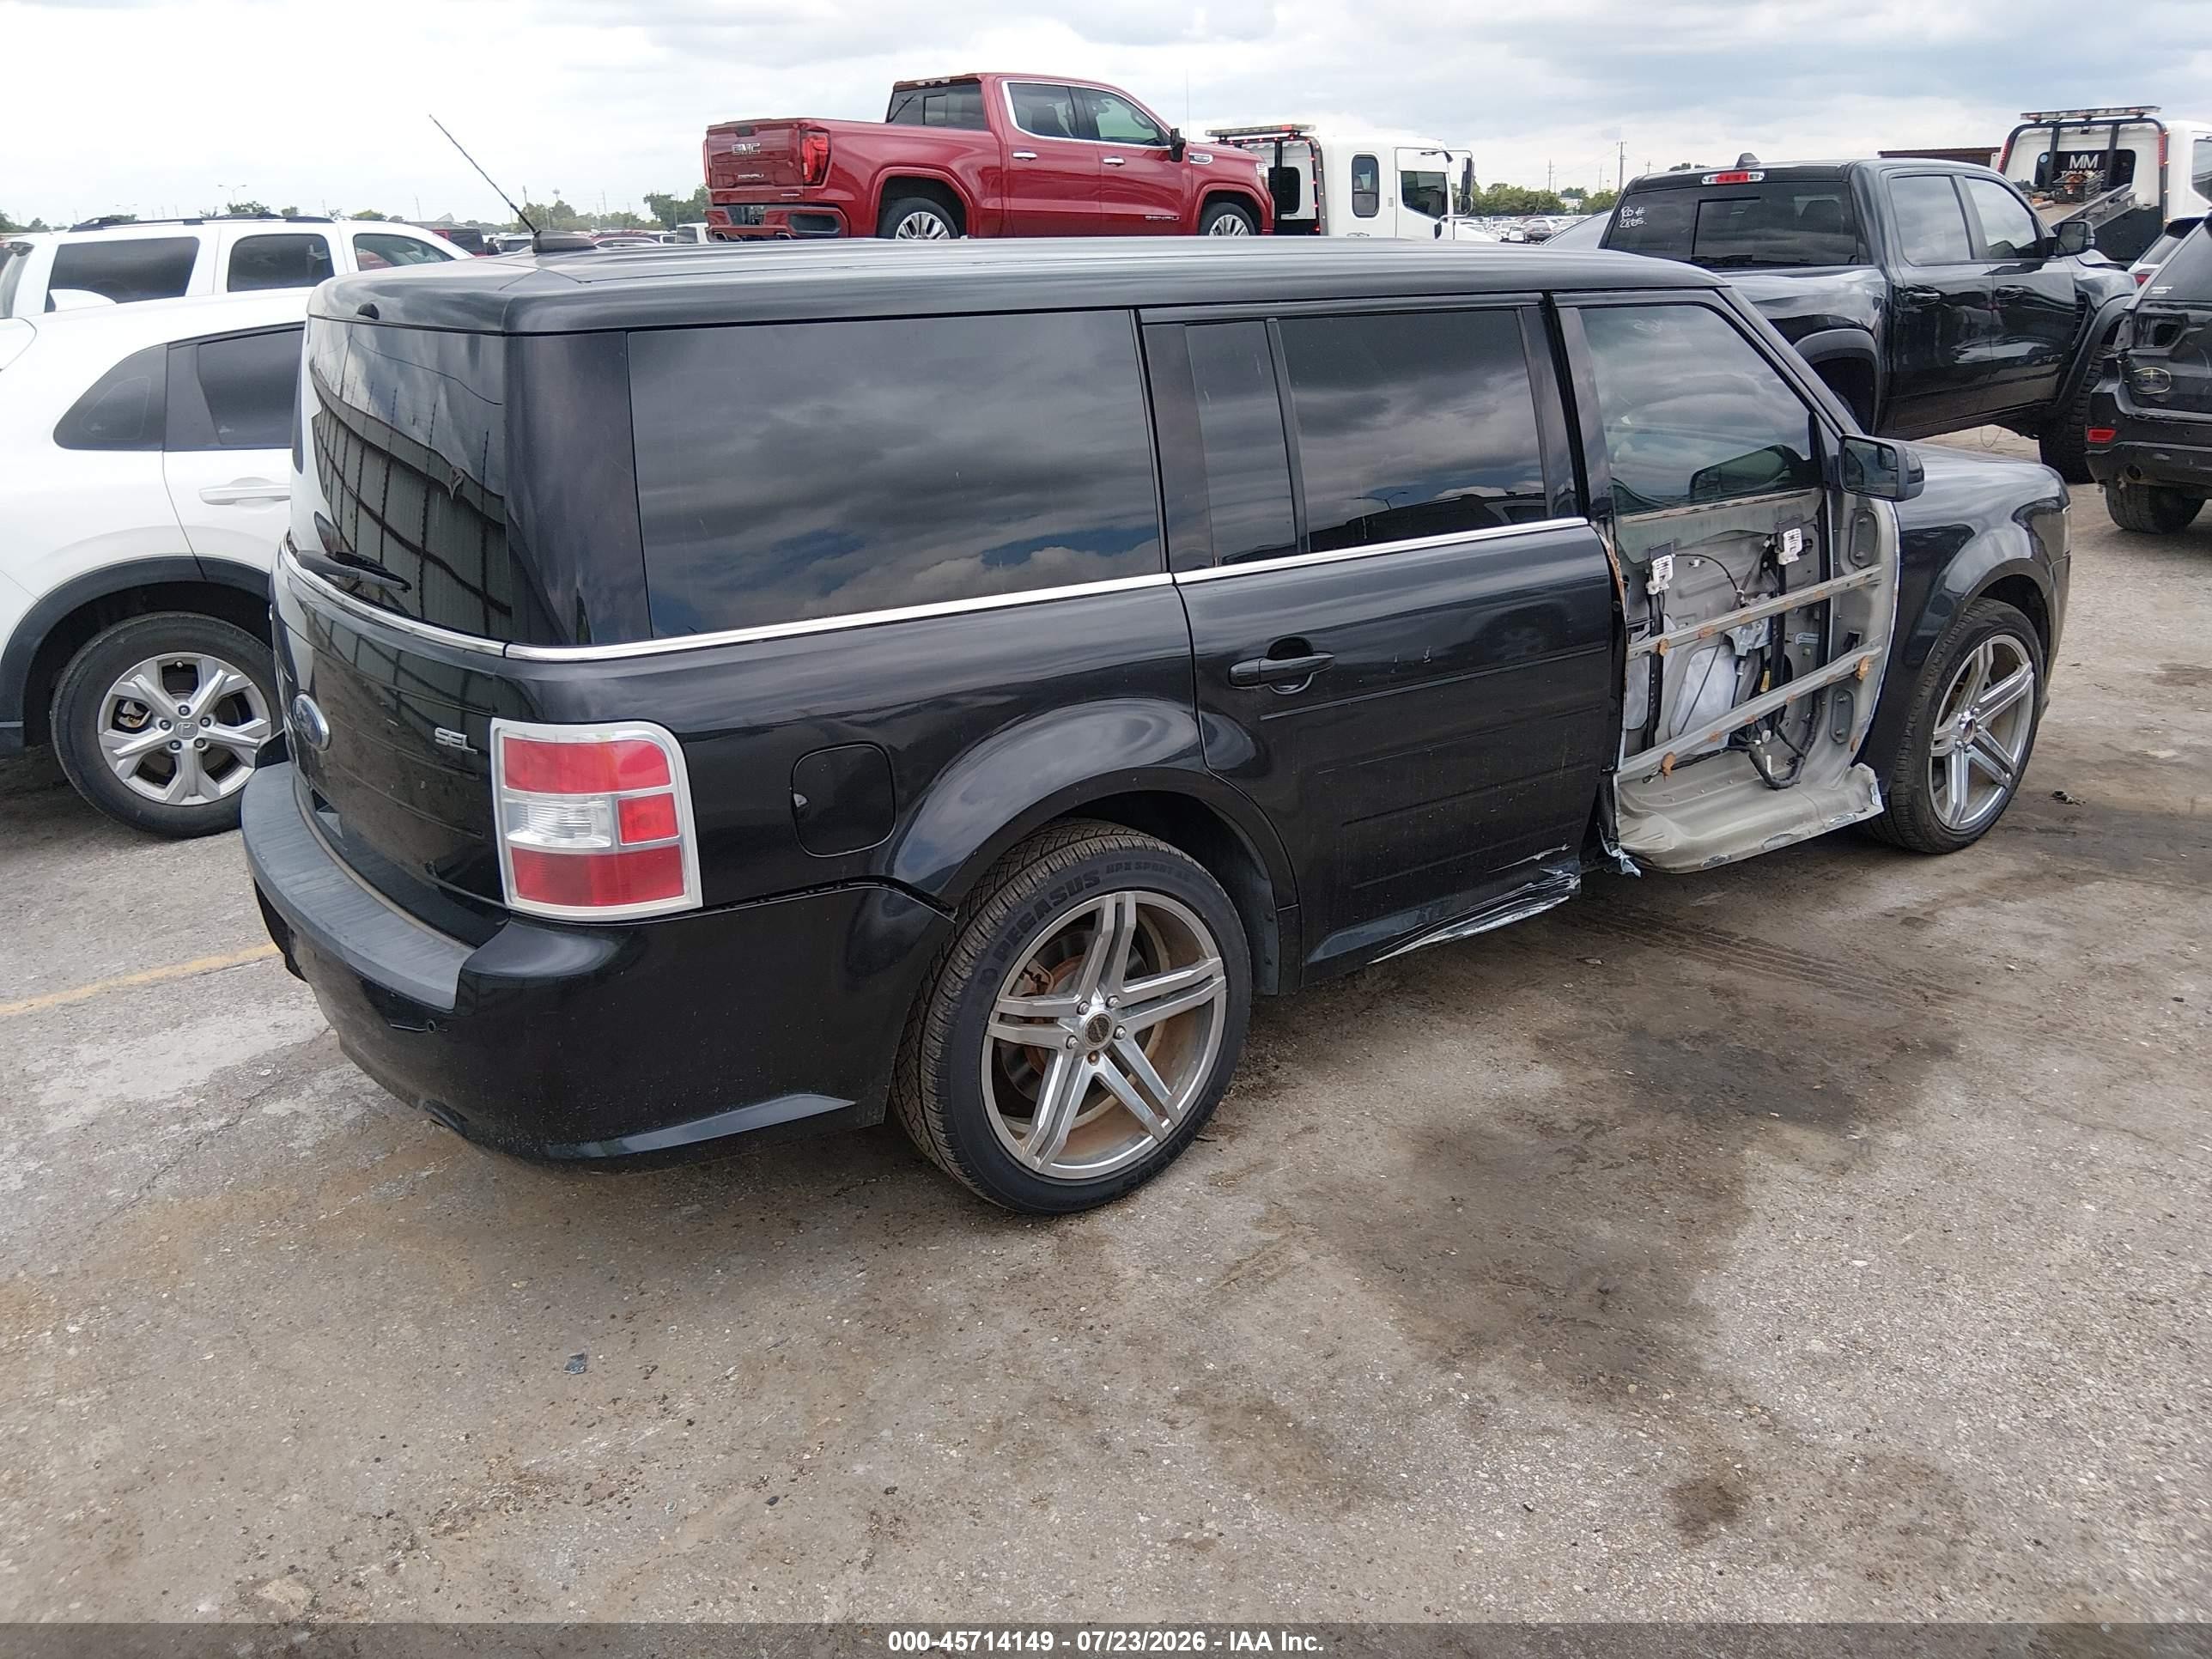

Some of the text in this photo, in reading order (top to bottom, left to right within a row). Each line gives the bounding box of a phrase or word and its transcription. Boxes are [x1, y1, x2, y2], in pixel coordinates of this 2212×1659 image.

[732, 143, 761, 155] GMC
[2069, 154, 2100, 169] MM
[434, 726, 478, 755] SEL
[993, 868, 1101, 963] PEGASUS
